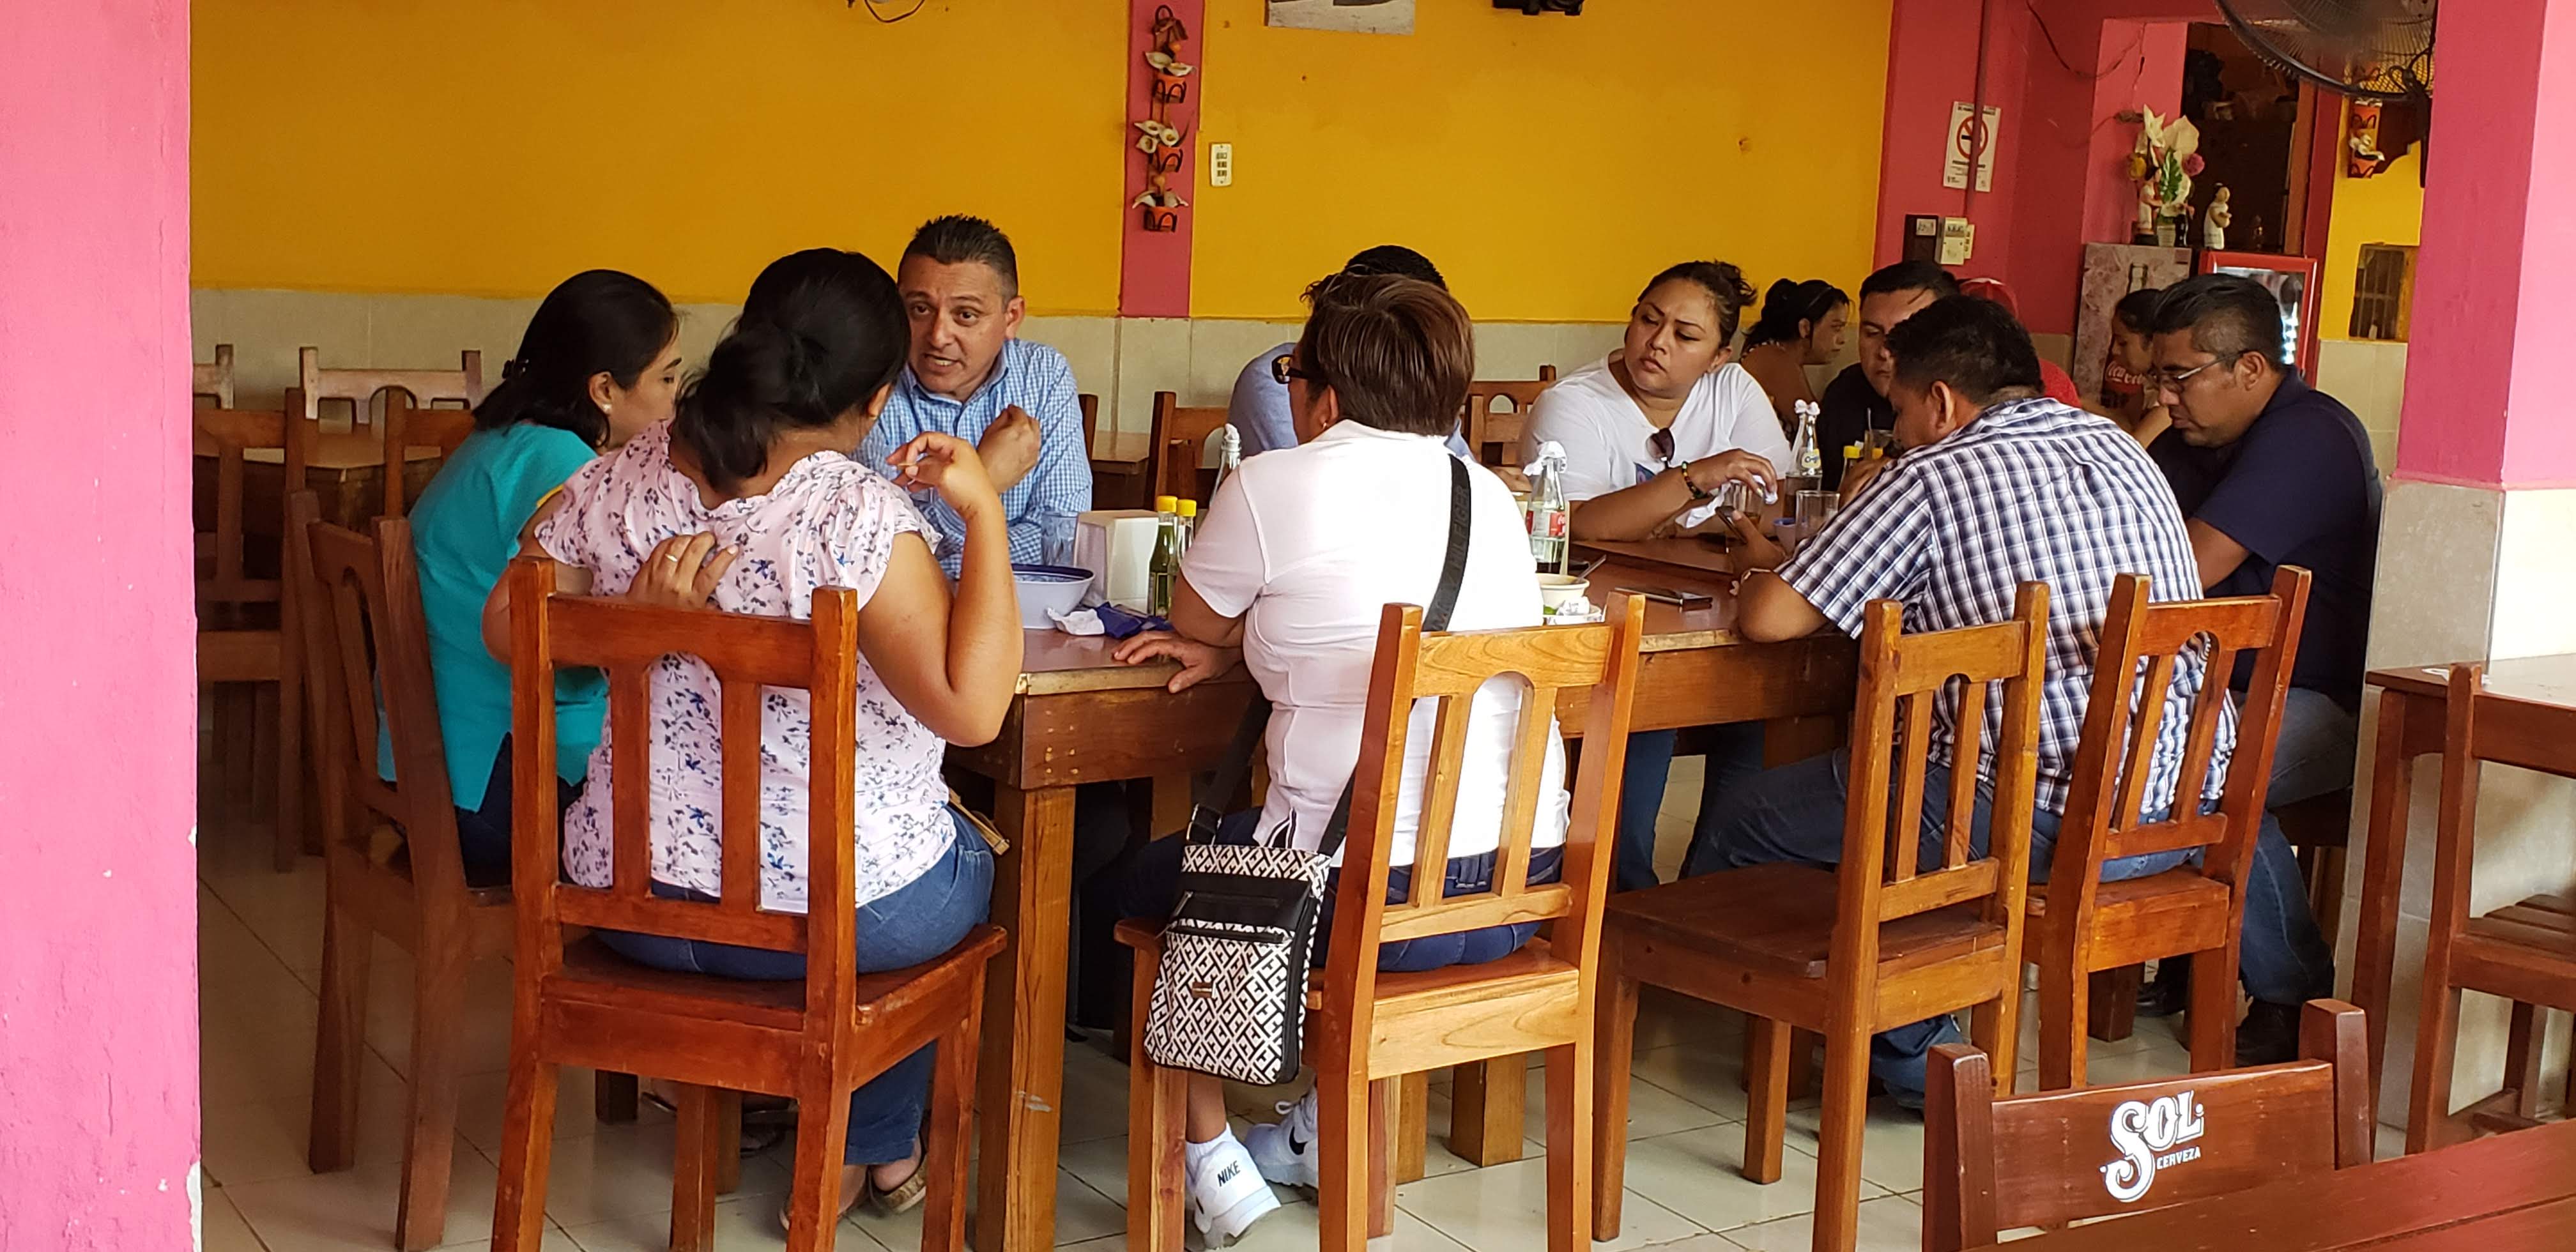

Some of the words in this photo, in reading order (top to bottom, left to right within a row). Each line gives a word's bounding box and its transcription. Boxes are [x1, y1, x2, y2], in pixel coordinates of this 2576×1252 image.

[2099, 1090, 2204, 1203] SOL
[2157, 1146, 2201, 1170] CERVEZA
[1217, 1159, 1241, 1187] NIKE
